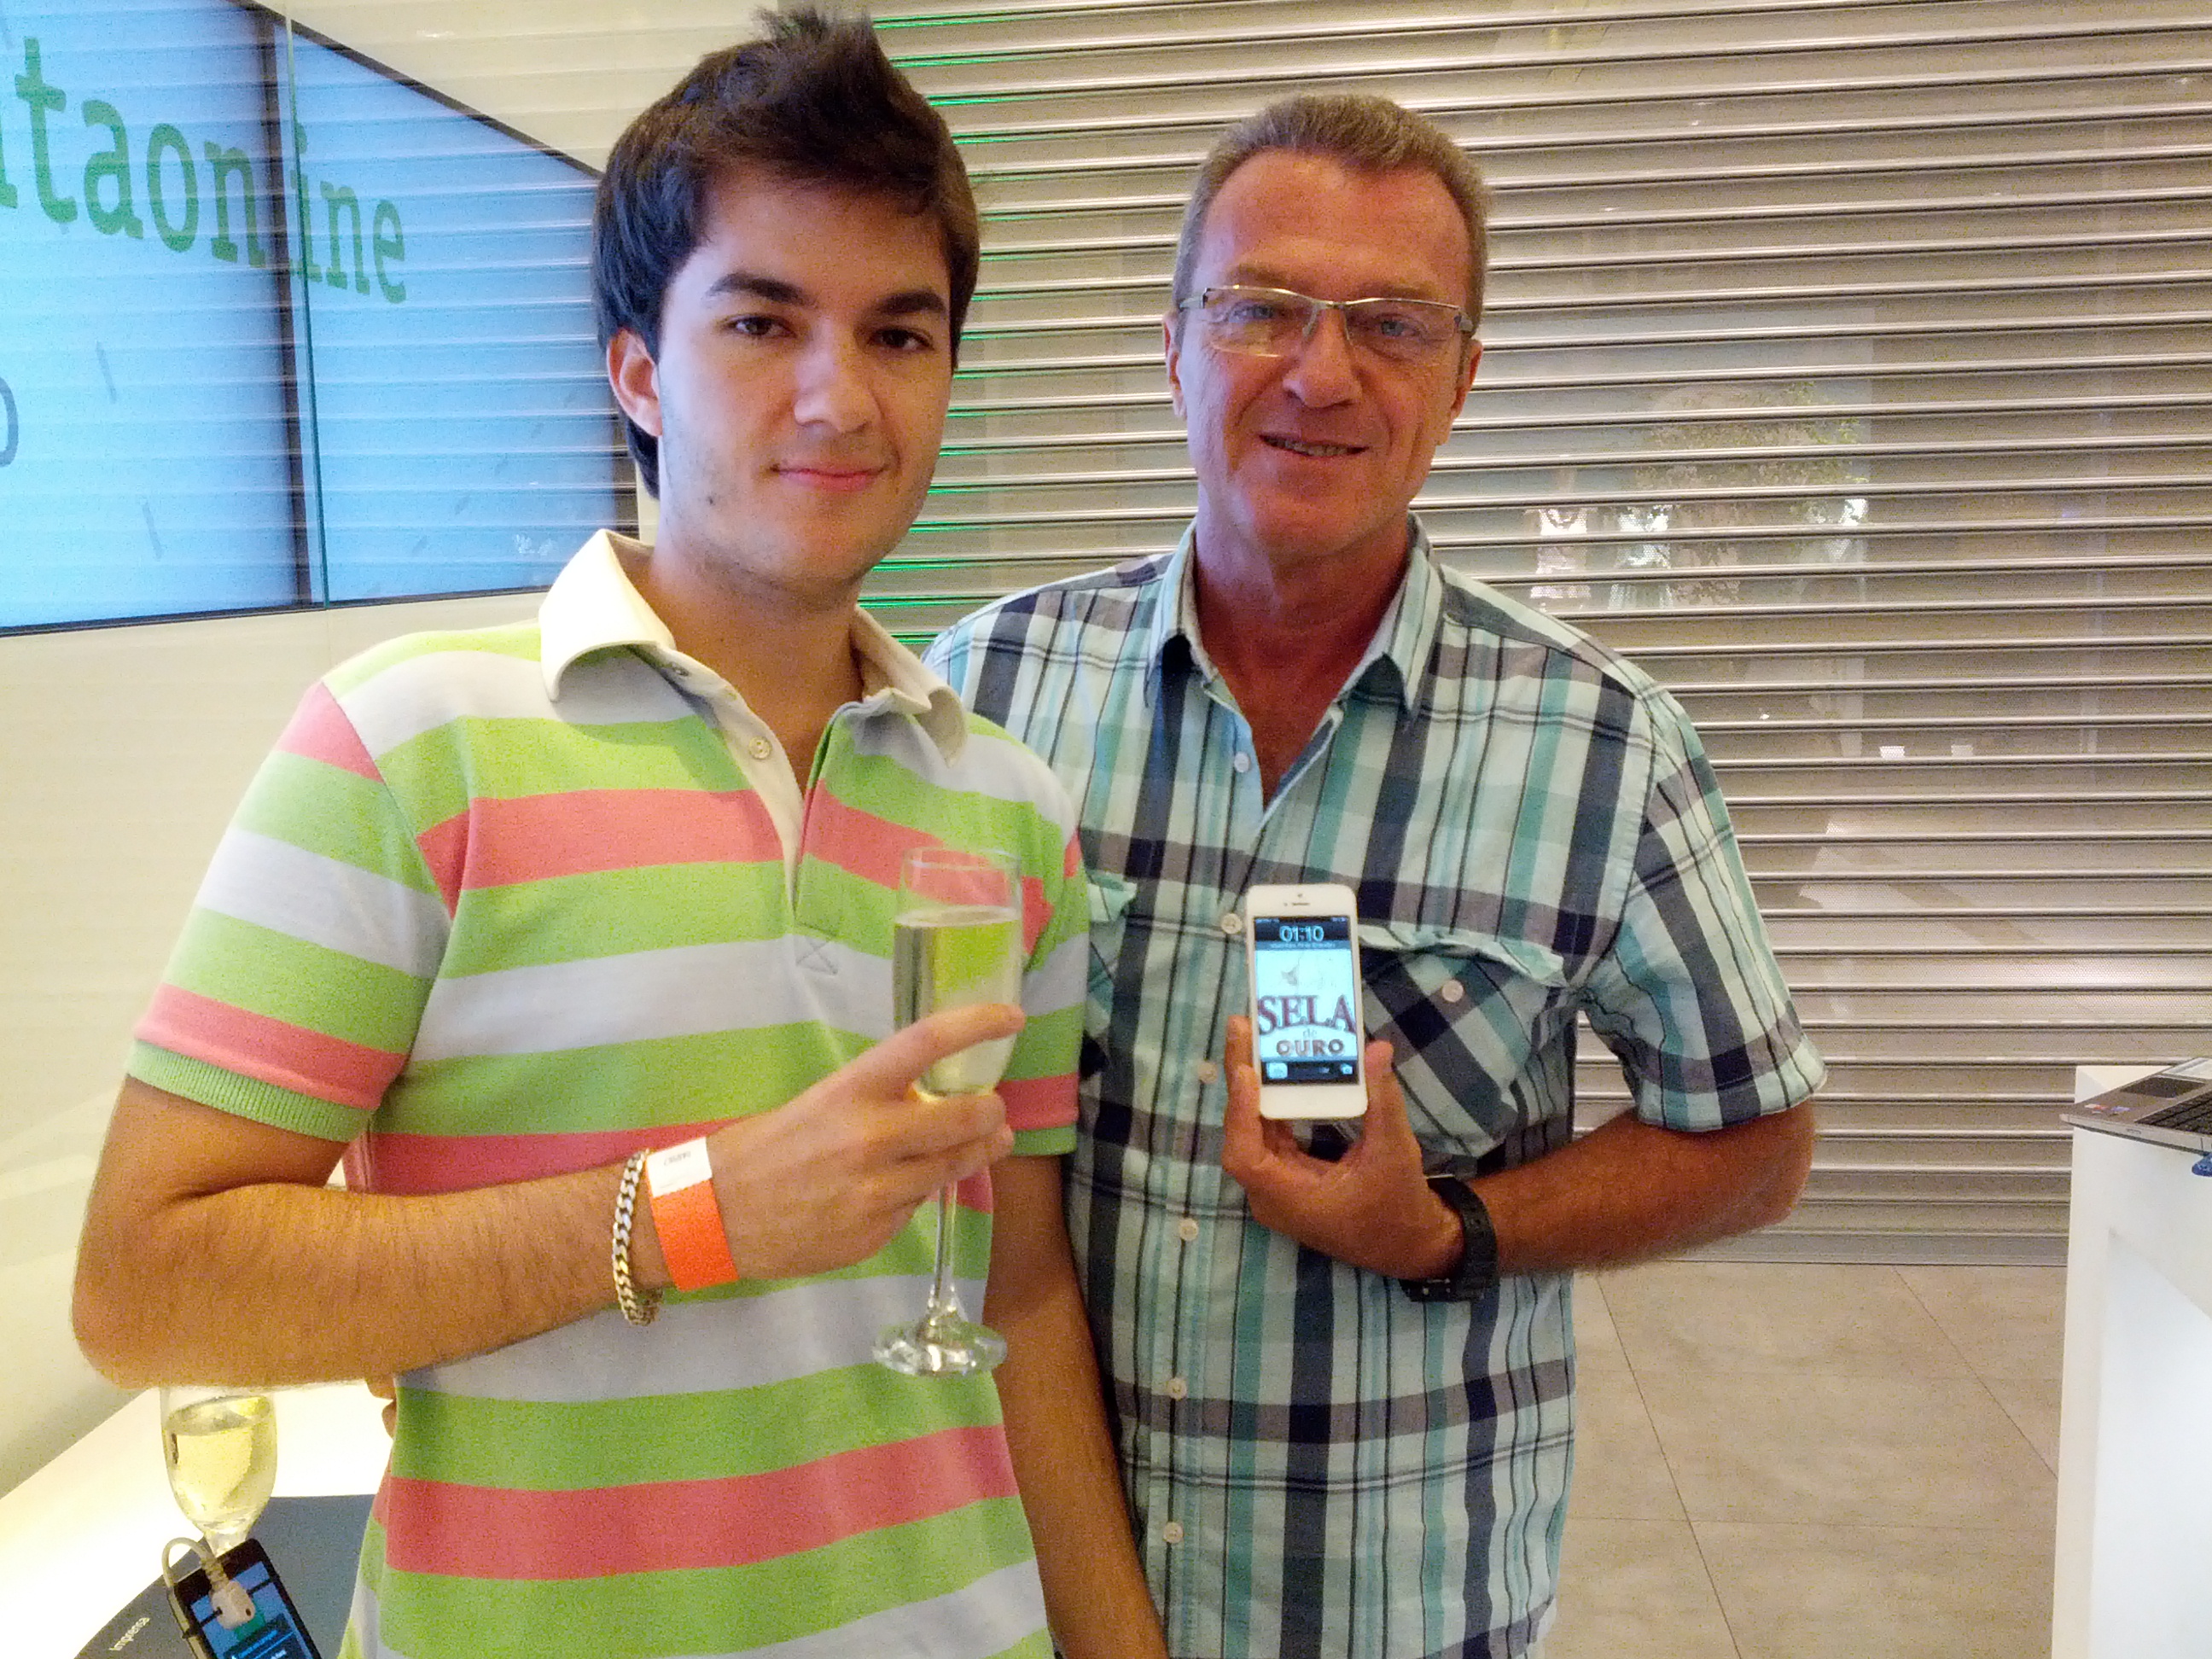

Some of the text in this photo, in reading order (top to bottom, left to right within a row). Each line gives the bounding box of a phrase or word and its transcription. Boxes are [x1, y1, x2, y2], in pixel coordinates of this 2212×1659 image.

[1279, 925, 1324, 942] 01:10
[1257, 994, 1356, 1035] SELA
[1276, 1039, 1344, 1057] OURO
